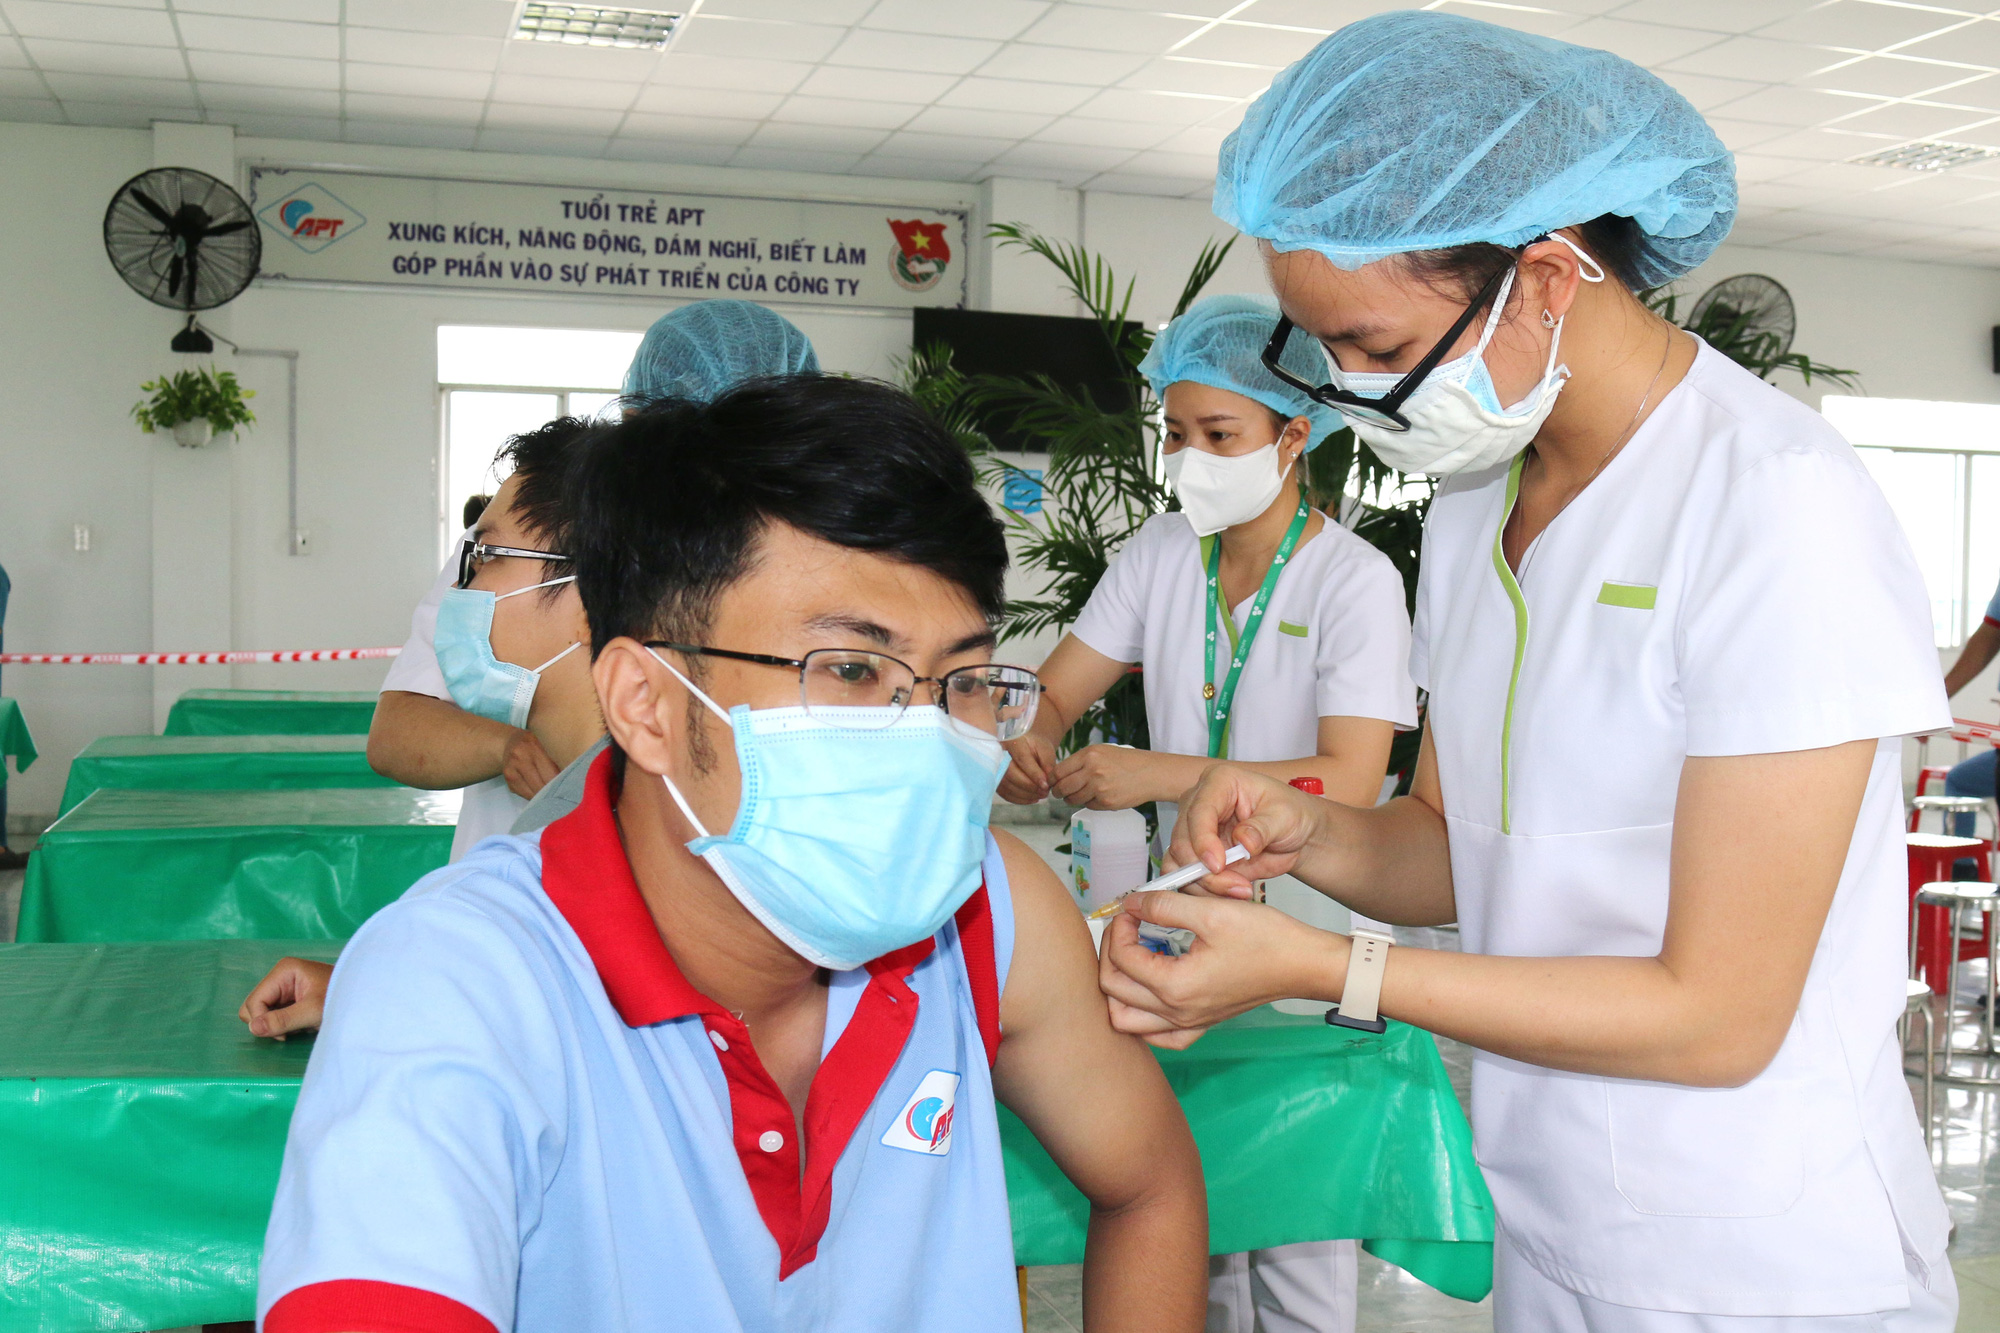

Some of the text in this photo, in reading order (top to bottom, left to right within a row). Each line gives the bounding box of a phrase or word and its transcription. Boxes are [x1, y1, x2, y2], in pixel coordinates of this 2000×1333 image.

[293, 217, 344, 237] APT
[560, 193, 705, 227] TUỔI TRẺ APT
[388, 221, 866, 266] XUNG KÍCH, NĂNG ĐỘNG, DÁM NGHĨ, BIẾT LÀM
[392, 251, 860, 297] GÓP PHẦN VÀO SỰ PHÁT TRIỂN CỦA CÔNG TY
